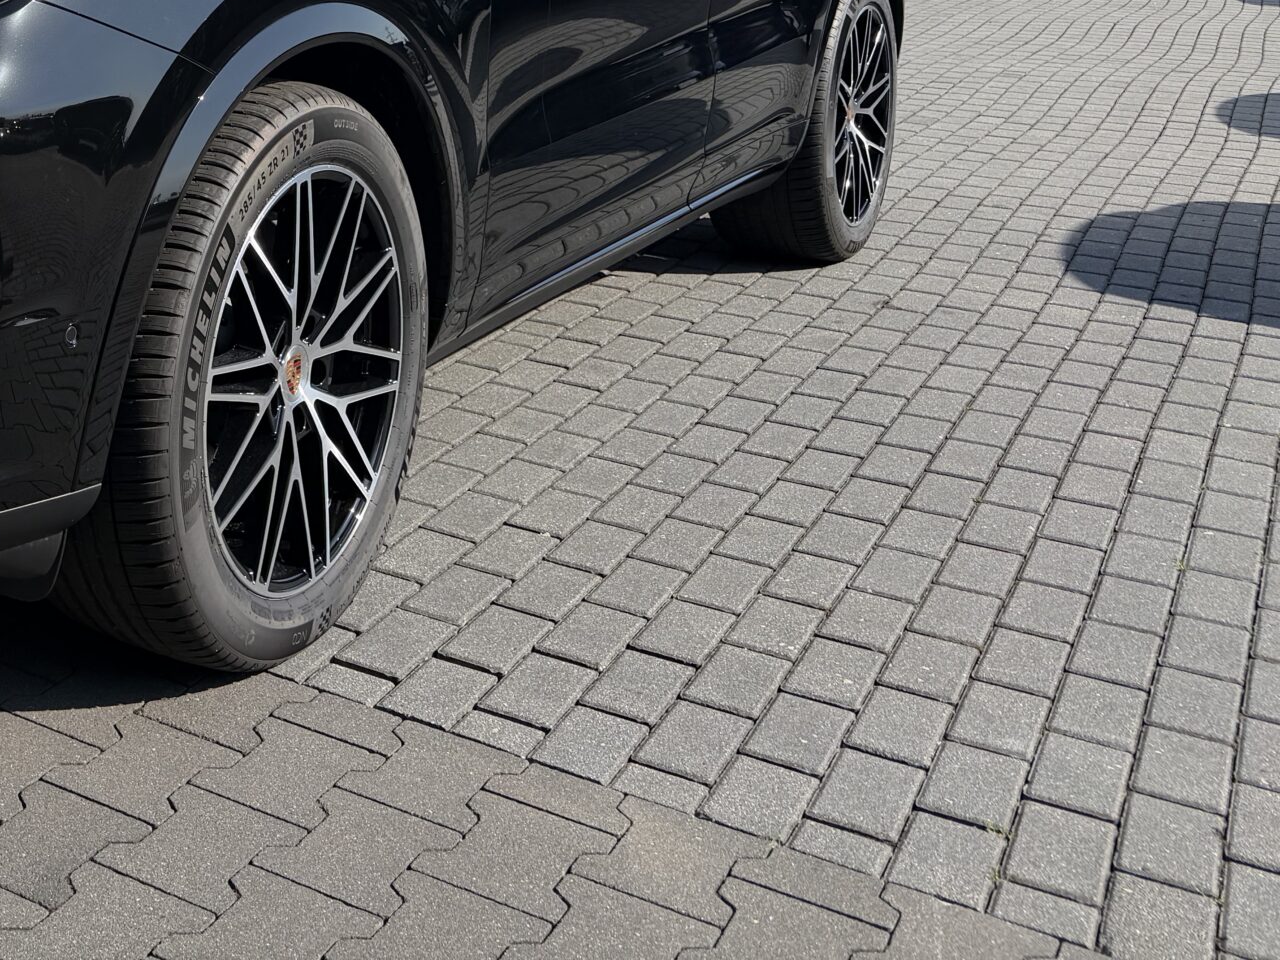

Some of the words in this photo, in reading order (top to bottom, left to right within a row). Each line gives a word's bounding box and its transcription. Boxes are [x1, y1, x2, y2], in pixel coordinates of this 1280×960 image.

[239, 171, 266, 222] 285/45
[267, 157, 279, 176] ZR
[280, 145, 290, 162] 21
[182, 237, 232, 450] MICHELIN
